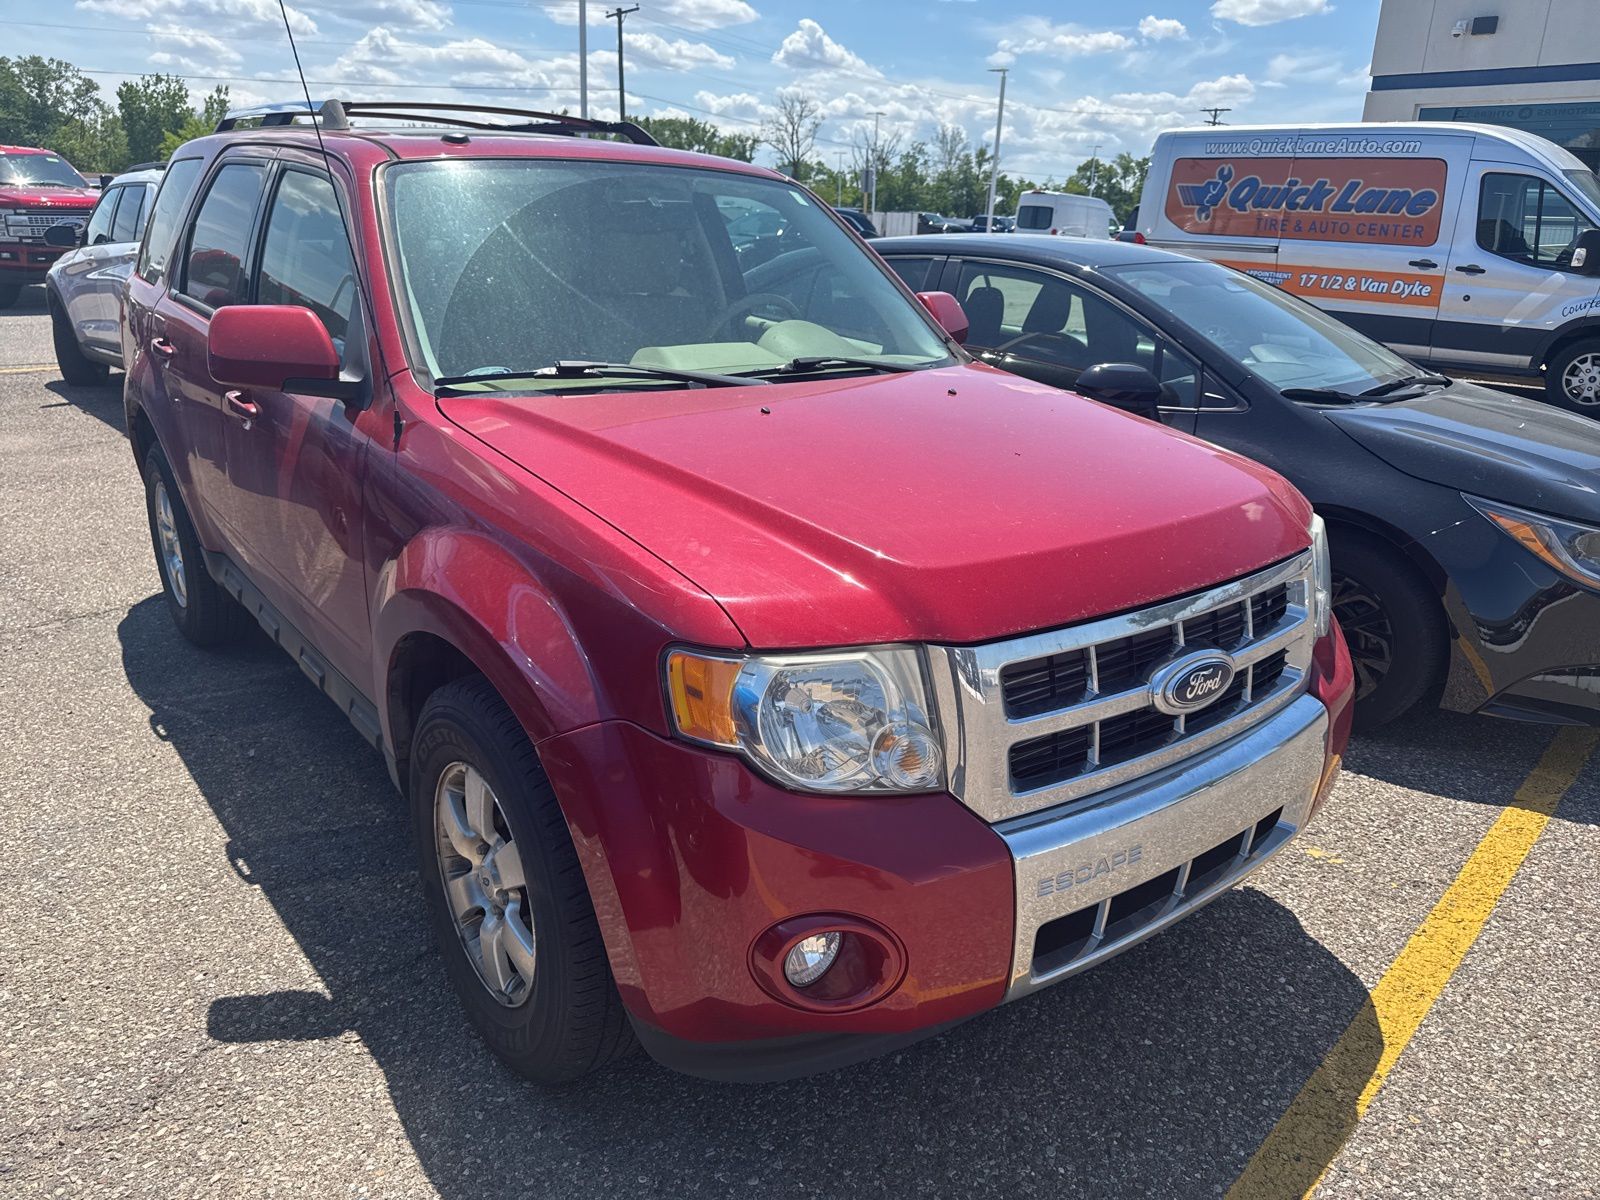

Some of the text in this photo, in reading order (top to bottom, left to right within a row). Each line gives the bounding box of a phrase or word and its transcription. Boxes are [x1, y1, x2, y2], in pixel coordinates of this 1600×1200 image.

[1206, 138, 1421, 155] www.QuickLaneAuto.com
[1229, 175, 1438, 216] Quick Lane
[1256, 217, 1424, 238] TIRE & AUTO CENTER
[1299, 273, 1432, 299] 17 1/2 & Van Dyke
[1186, 668, 1222, 699] Ford
[1037, 844, 1142, 897] ESCAPE
